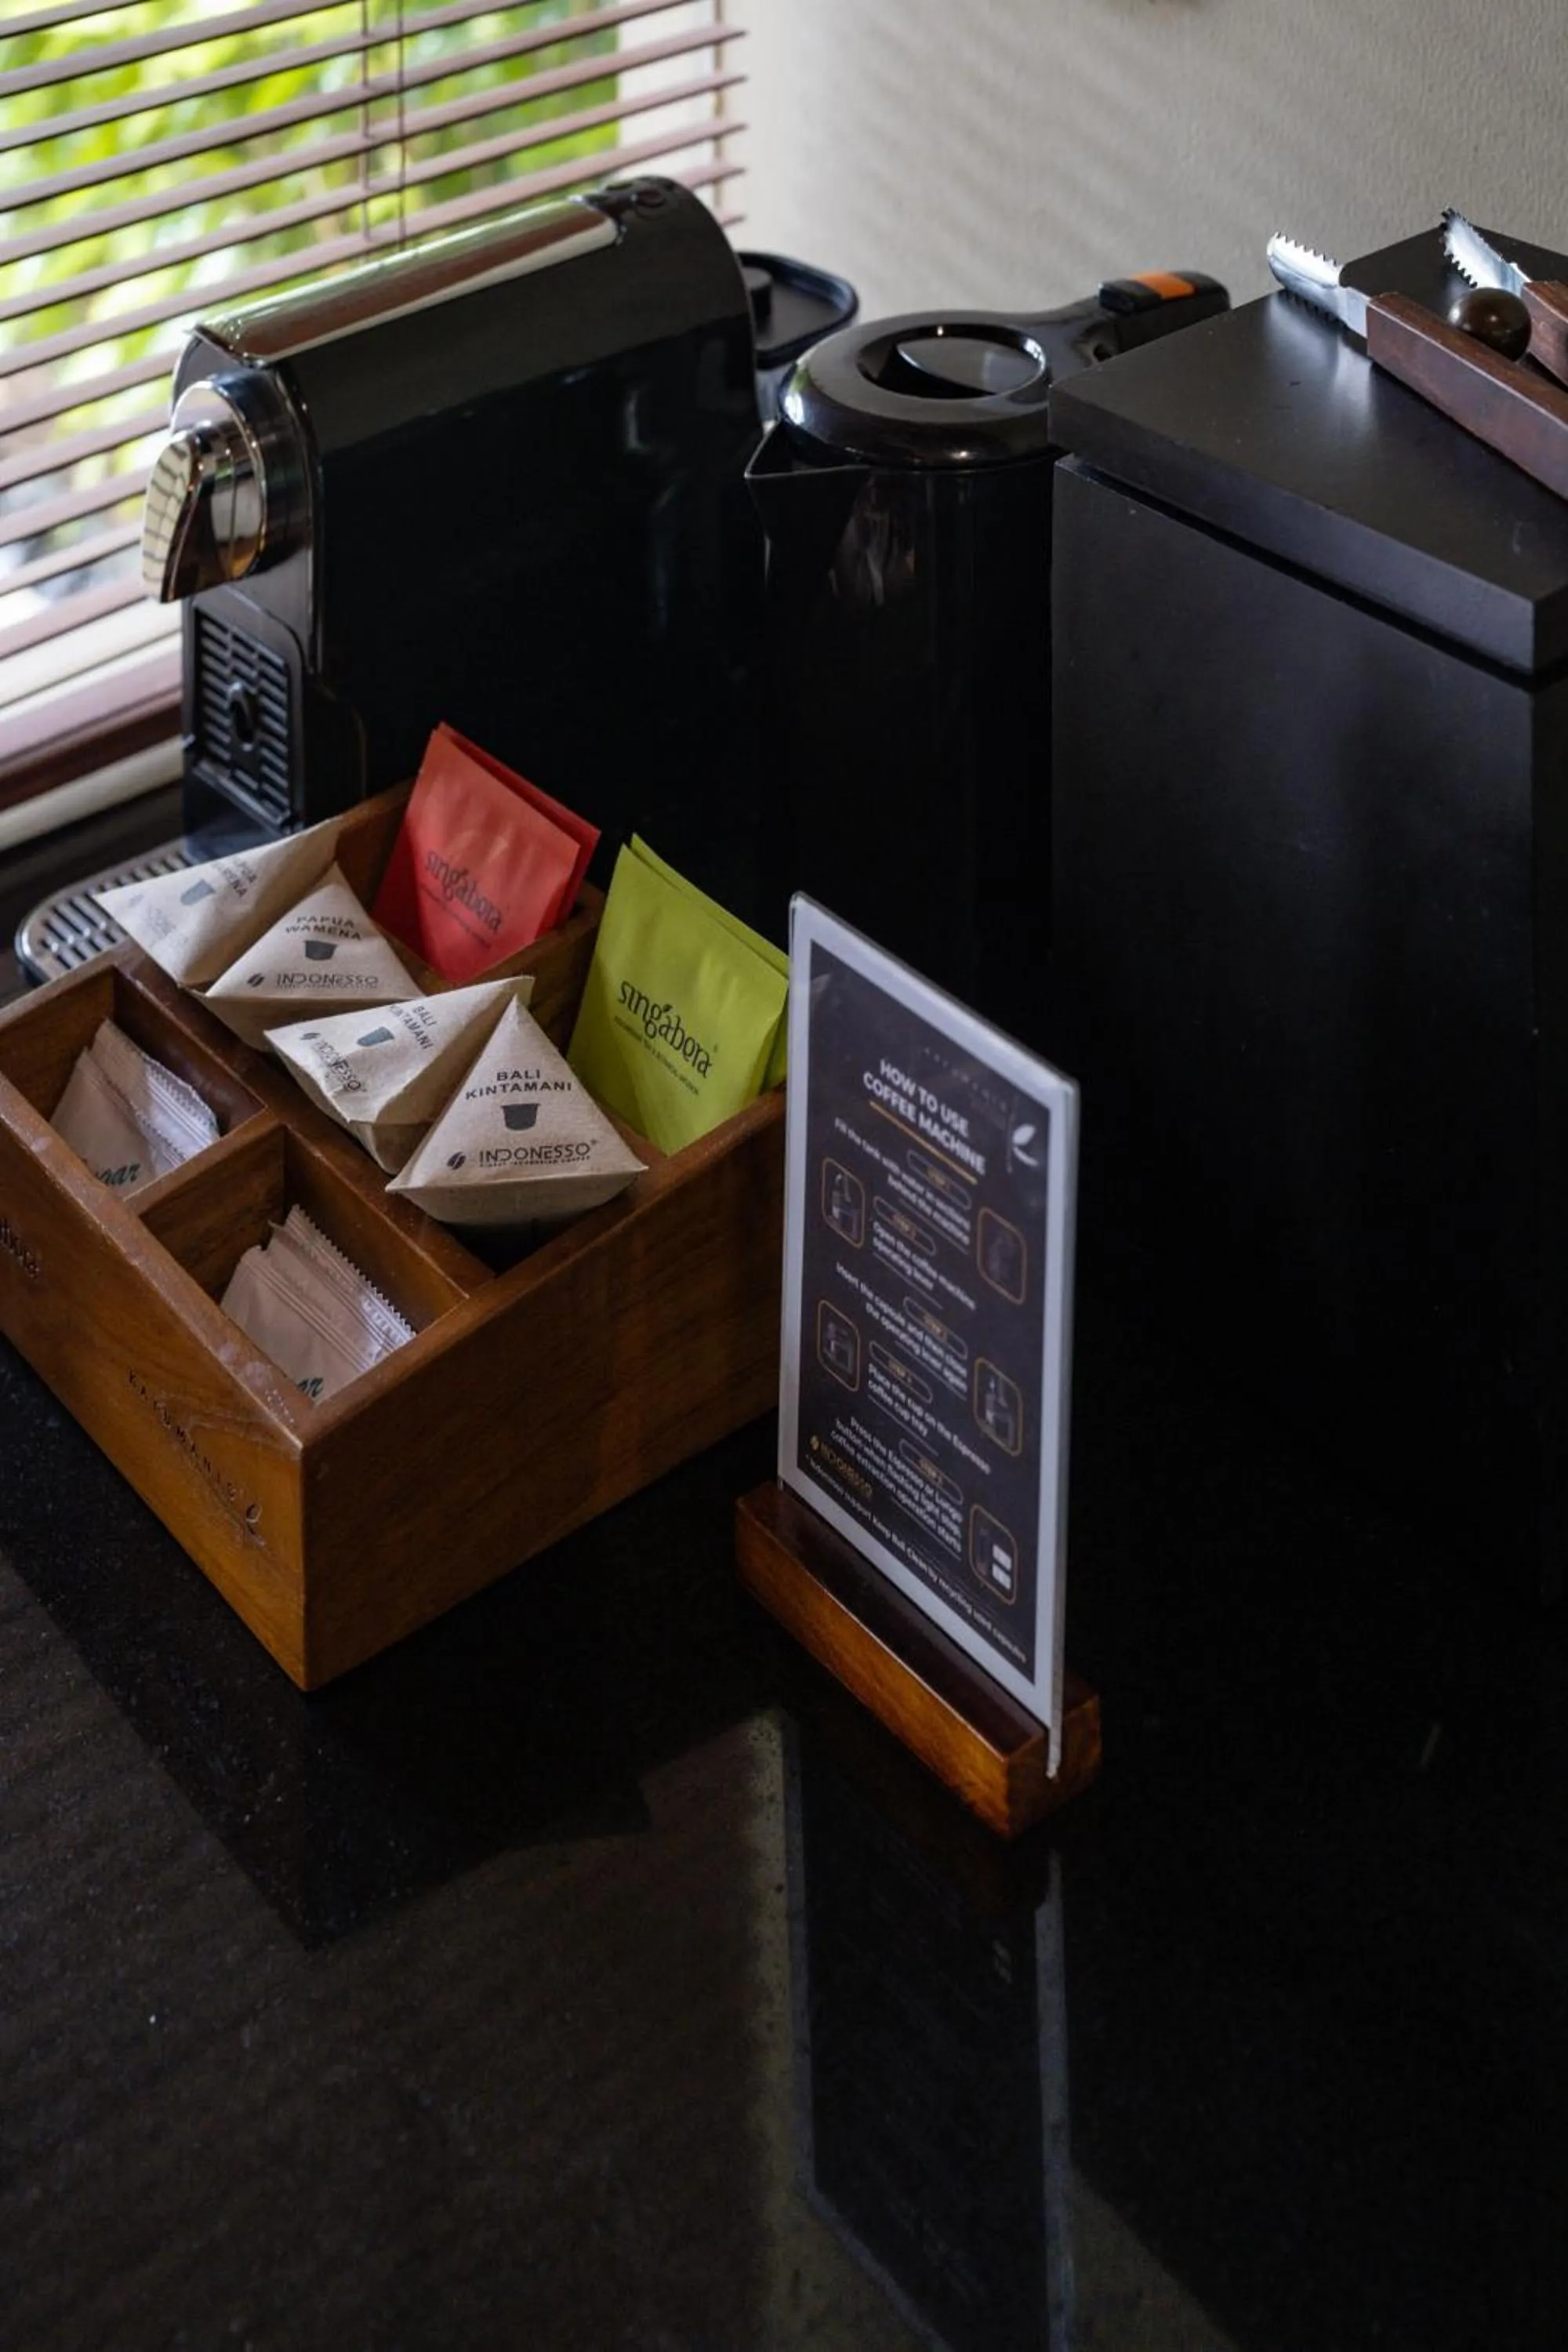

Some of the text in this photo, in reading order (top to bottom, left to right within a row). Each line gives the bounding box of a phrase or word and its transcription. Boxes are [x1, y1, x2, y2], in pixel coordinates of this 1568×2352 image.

[285, 924, 362, 942] WAMENA
[297, 914, 356, 928] PAPUA
[276, 972, 379, 987] INDONESSO
[412, 1005, 437, 1032] BALI
[495, 1069, 541, 1083] BALI
[465, 1082, 572, 1100] KINTAMANI
[880, 1059, 916, 1099] HOW
[919, 1087, 938, 1116] TO
[941, 1103, 968, 1138] USE
[864, 1069, 915, 1122] COFFEE
[919, 1112, 985, 1175] MACHINE
[478, 1142, 591, 1163] INDONESSO
[869, 1363, 890, 1388] Place
[892, 1383, 905, 1401] the
[908, 1397, 923, 1418] cup
[894, 1400, 909, 1422] cup
[912, 1416, 927, 1439] tray
[851, 1417, 871, 1443] Press
[873, 1436, 886, 1455] the
